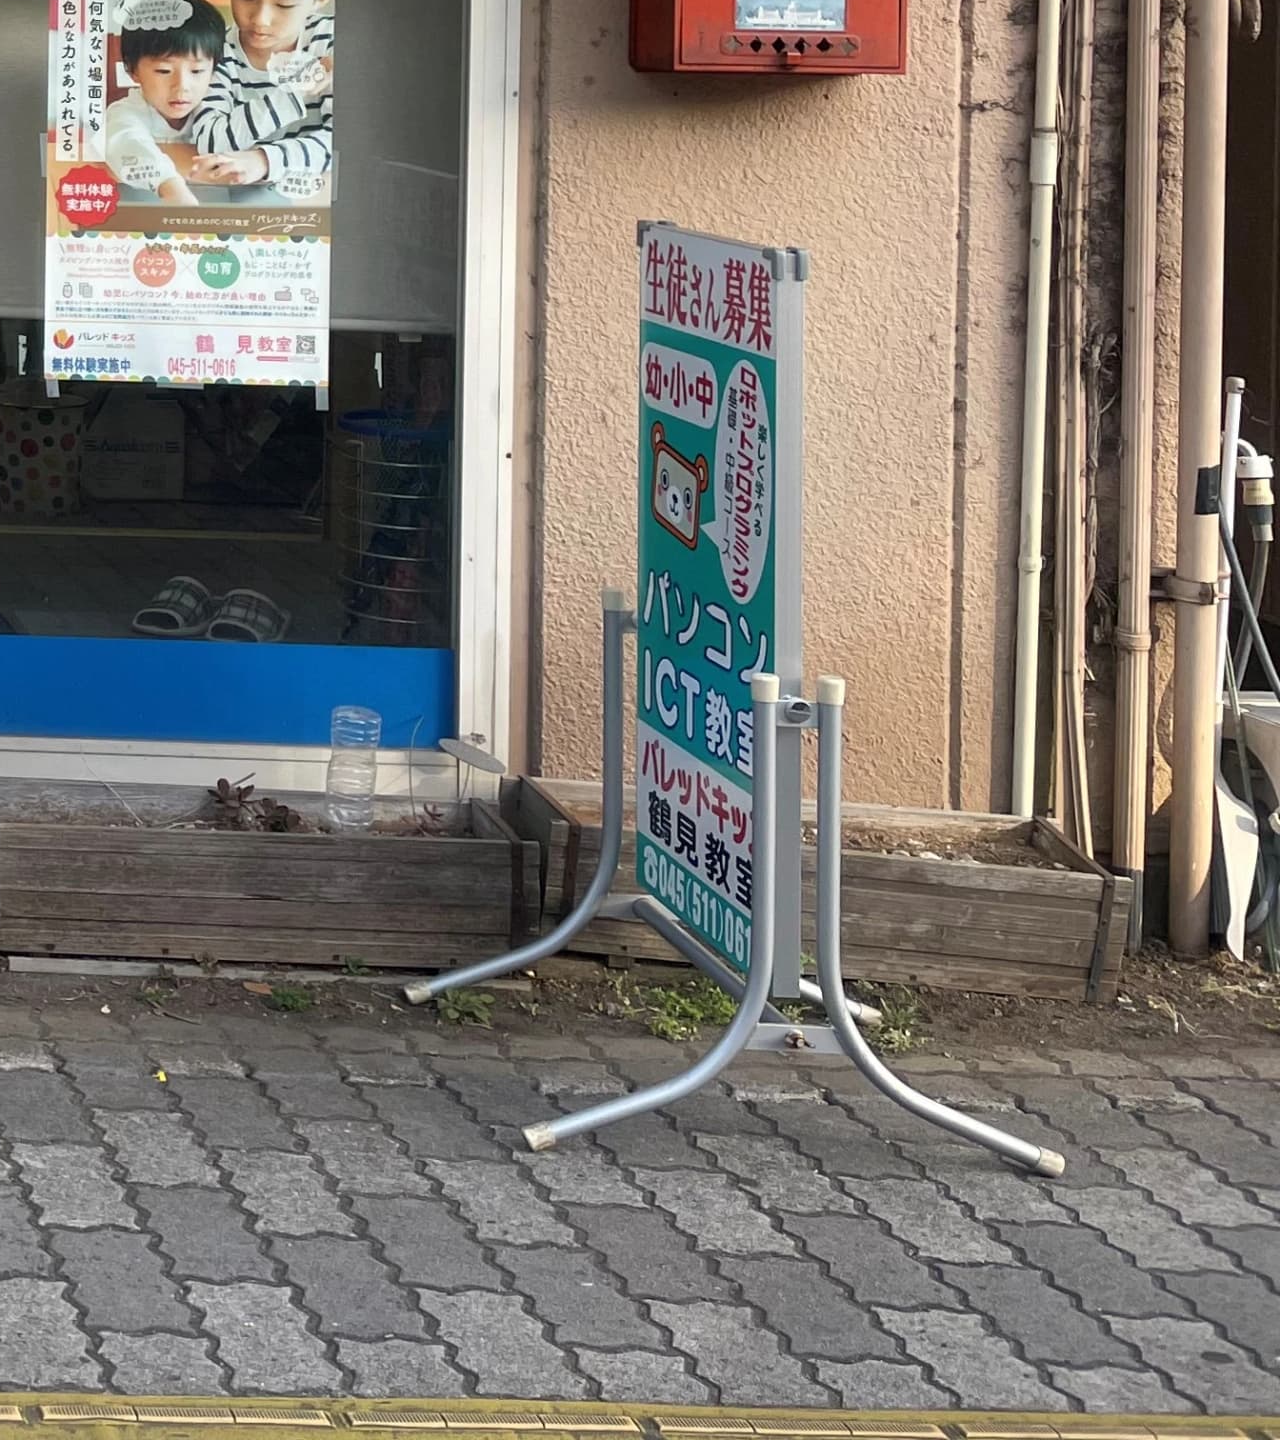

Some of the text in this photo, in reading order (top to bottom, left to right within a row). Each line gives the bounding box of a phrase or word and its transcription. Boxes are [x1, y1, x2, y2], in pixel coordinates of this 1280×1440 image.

[88, 0, 105, 132] 何気ない場面にも
[61, 183, 114, 197] 無料体験
[135, 257, 173, 268] パソコン
[204, 261, 234, 276] 知育
[644, 238, 774, 352] 生徒さん募集
[51, 356, 132, 374] 無料体験実施中
[167, 356, 236, 377] 045-511-0616
[645, 353, 715, 420] 幼・小・中
[731, 365, 758, 600] ロボットプログラミング
[643, 570, 769, 685] パソコン
[641, 738, 753, 854] バレッドキッ
[658, 857, 752, 968] 045(511)061
